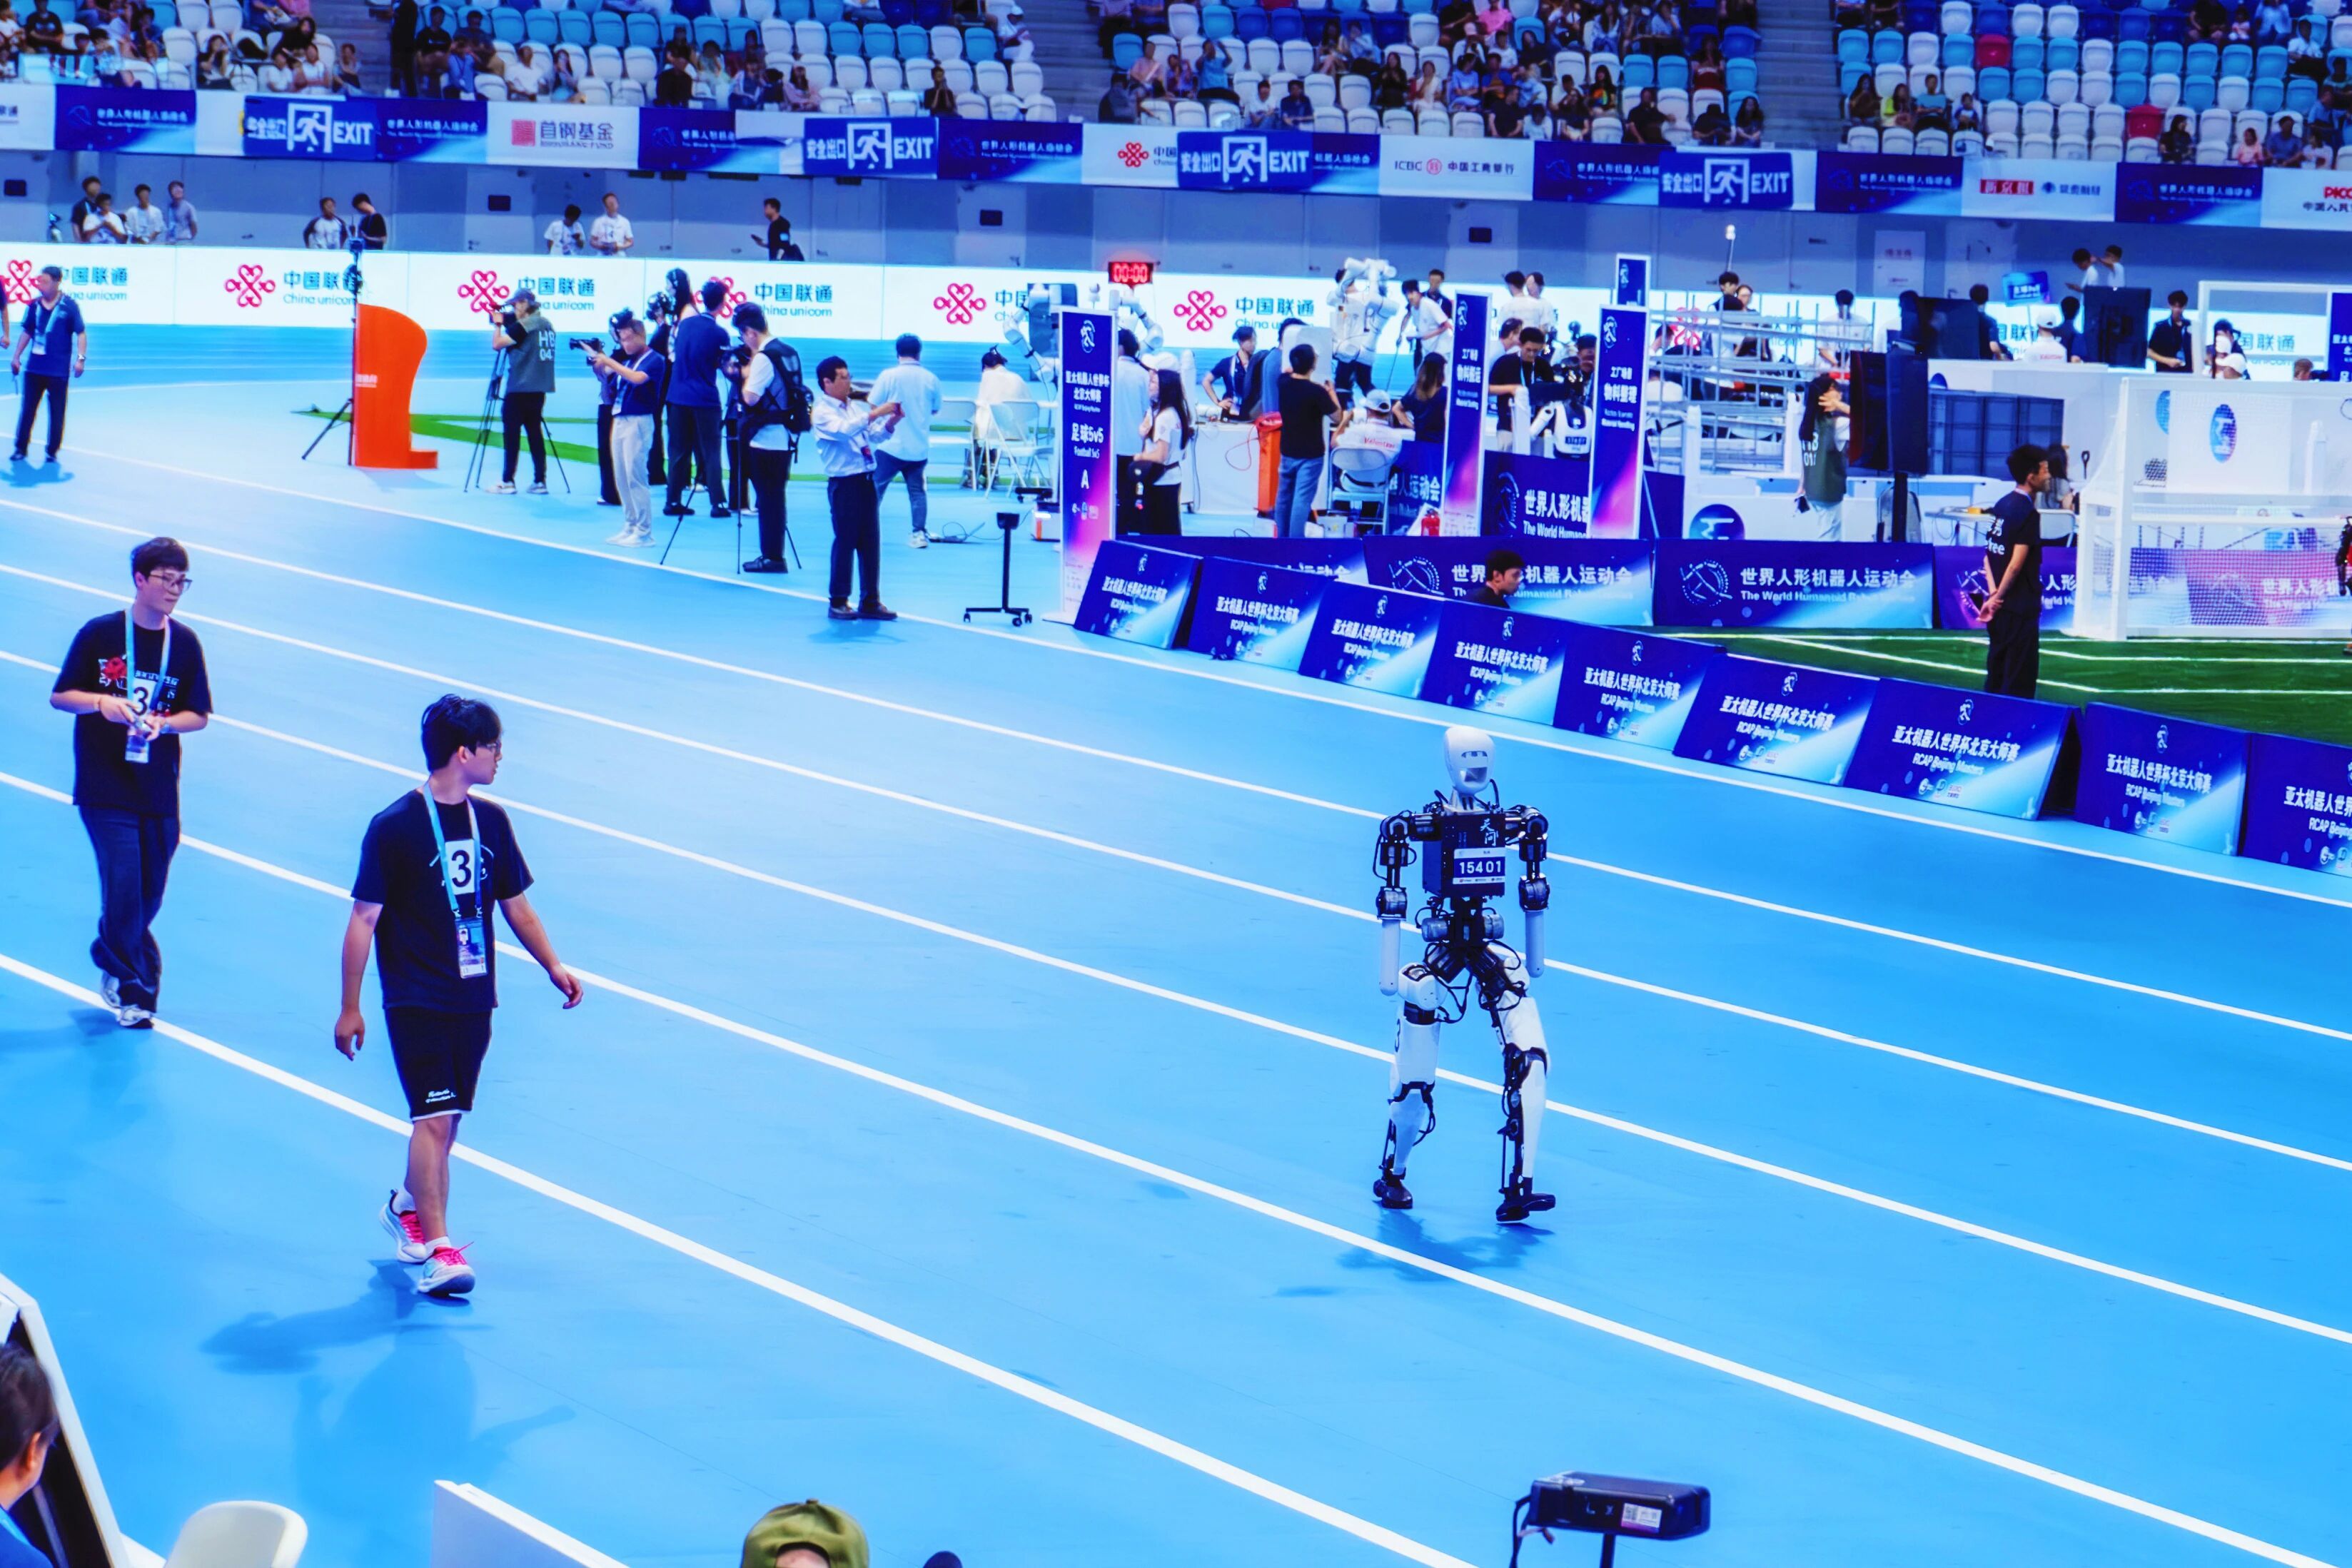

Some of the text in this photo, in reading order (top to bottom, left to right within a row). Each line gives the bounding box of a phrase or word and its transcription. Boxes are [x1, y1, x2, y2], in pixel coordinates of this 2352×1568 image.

[333, 121, 374, 145] EXIT
[540, 121, 613, 141] 首钢基金
[807, 138, 847, 159] 安全出口
[894, 137, 934, 159] EXIT
[1181, 151, 1221, 173] 安全出口
[1269, 151, 1310, 173] EXIT
[1395, 161, 1423, 171] ICBC
[1448, 161, 1515, 176] 中国工商银行
[1662, 172, 1703, 193] 安全出口
[1751, 172, 1790, 193] EXIT
[2303, 201, 2352, 213] 中国人民
[1112, 263, 1148, 283] 00:00
[518, 276, 595, 297] 中国联通
[755, 283, 833, 303] 中国联通
[283, 293, 316, 304] China
[552, 300, 595, 310] unicom
[1236, 296, 1314, 316] 中国联通
[763, 304, 833, 317] hina unicom
[1071, 422, 1104, 443] 足球5v5
[1080, 469, 1089, 490] A
[1451, 564, 1633, 585] 世界机器人运动会
[1740, 567, 1917, 589] 世界人形机器人运动会
[1452, 586, 1467, 597] Th
[1512, 587, 1564, 600] umanoid
[1740, 590, 1760, 601] The
[1762, 591, 1793, 602] World
[1795, 592, 1847, 602] Humanoid
[1454, 641, 1549, 674] 亚太机器人世界杯北京大师赛
[1583, 667, 1681, 701] 亚太机器人世界杯北京大师赛
[133, 687, 148, 717] 3
[1719, 695, 1836, 732] 亚太机器人世界杯北京大师赛
[1736, 721, 1755, 734] RCAP
[1892, 725, 2021, 762] 亚太机器人世界杯北京大师赛
[1912, 752, 1932, 767] RCAP
[1932, 756, 1956, 774] Beijing
[2106, 753, 2212, 794] 亚太机器人世界杯北京大师赛
[2125, 783, 2142, 797] RCAP
[2308, 817, 2329, 833] RCAP
[451, 849, 472, 888] 3
[1459, 861, 1501, 874] 15401
